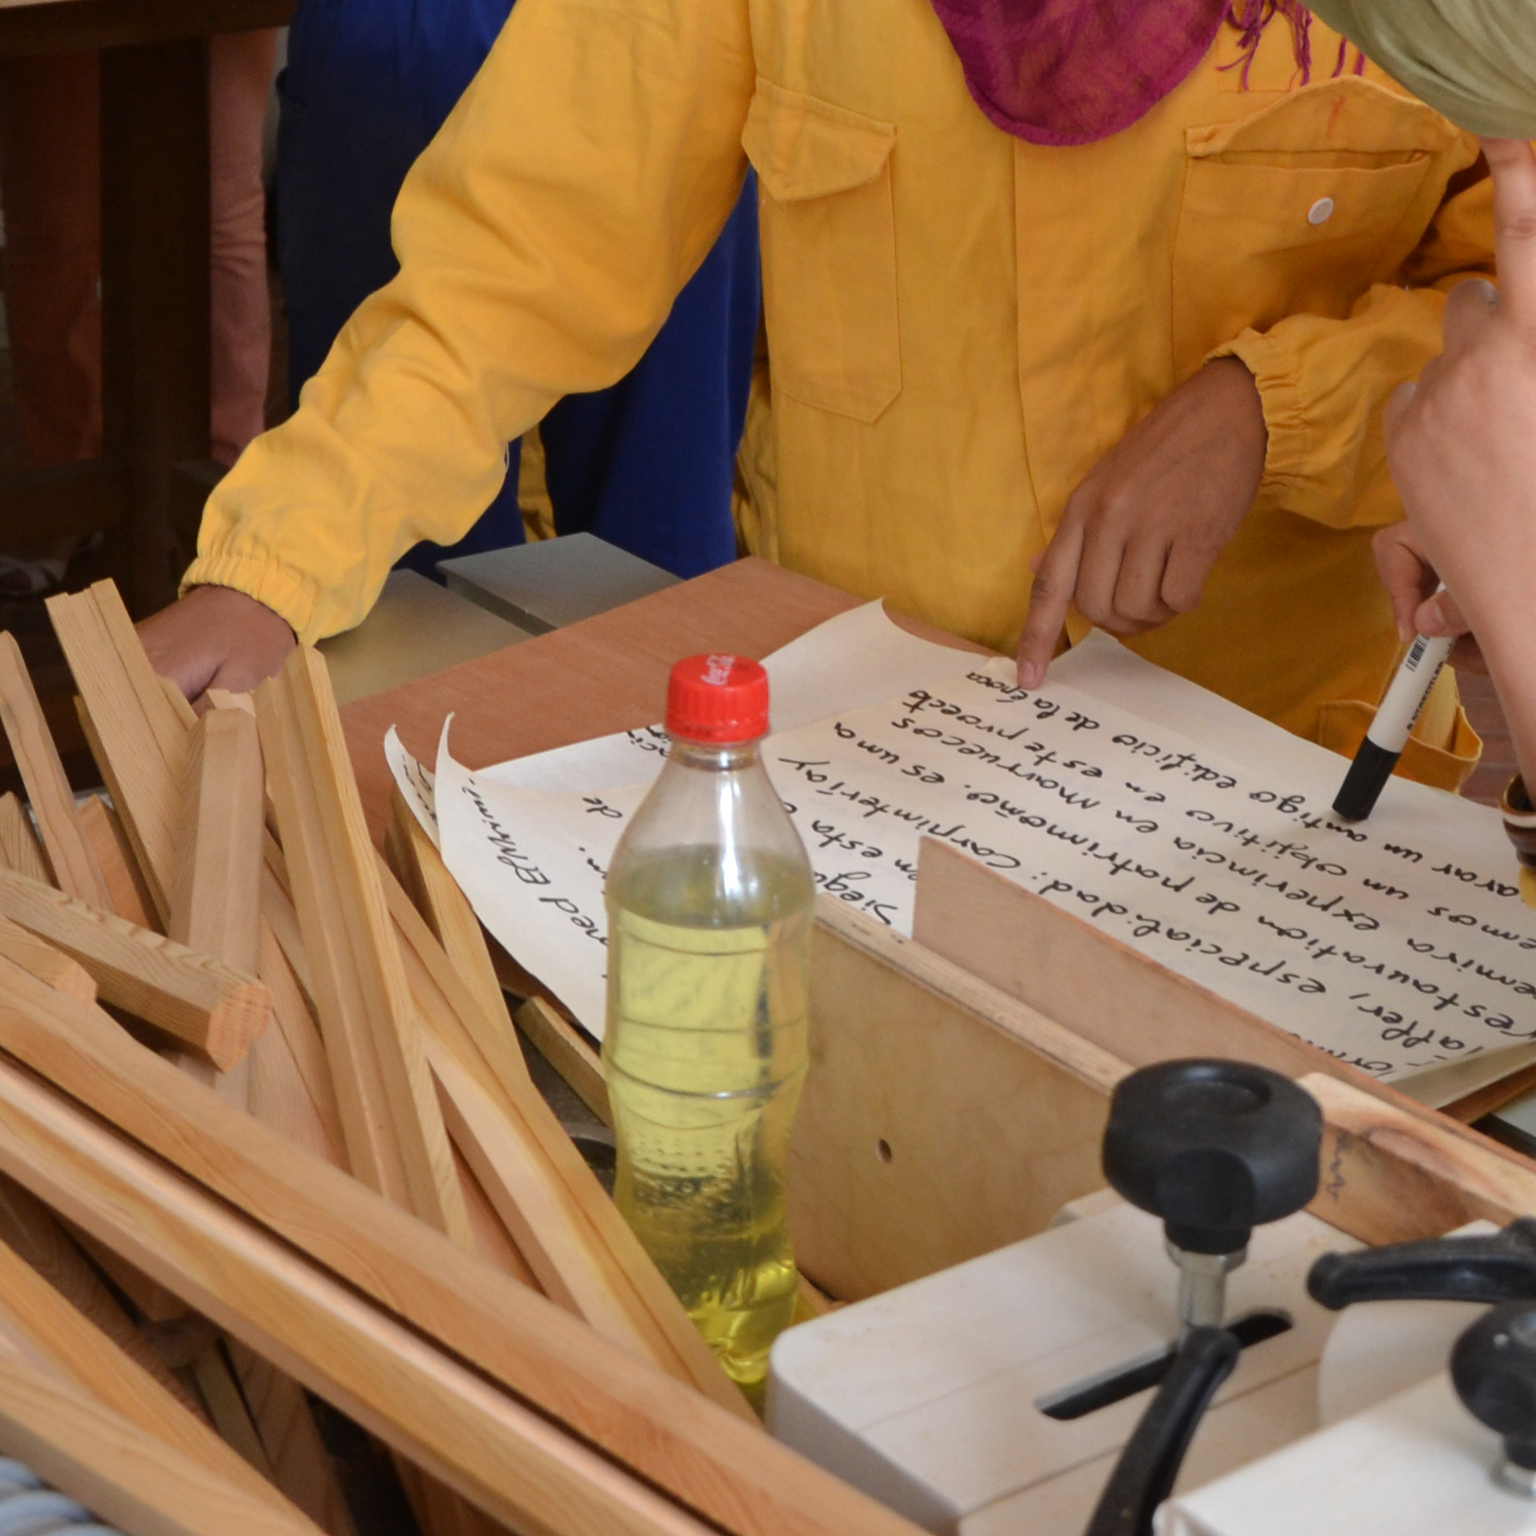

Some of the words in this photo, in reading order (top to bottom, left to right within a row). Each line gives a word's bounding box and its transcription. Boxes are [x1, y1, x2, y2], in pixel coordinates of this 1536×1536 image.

[1032, 697, 1060, 719] la
[1064, 711, 1099, 731] de
[1111, 733, 1236, 789] edificio
[900, 764, 945, 783] es
[1125, 781, 1166, 802] en
[582, 797, 622, 818] de
[1115, 809, 1159, 833] en
[810, 819, 883, 858] esta
[1383, 842, 1423, 863] un
[1362, 878, 1409, 899] un
[1195, 892, 1240, 915] de
[1032, 872, 1326, 993] especialidad:
